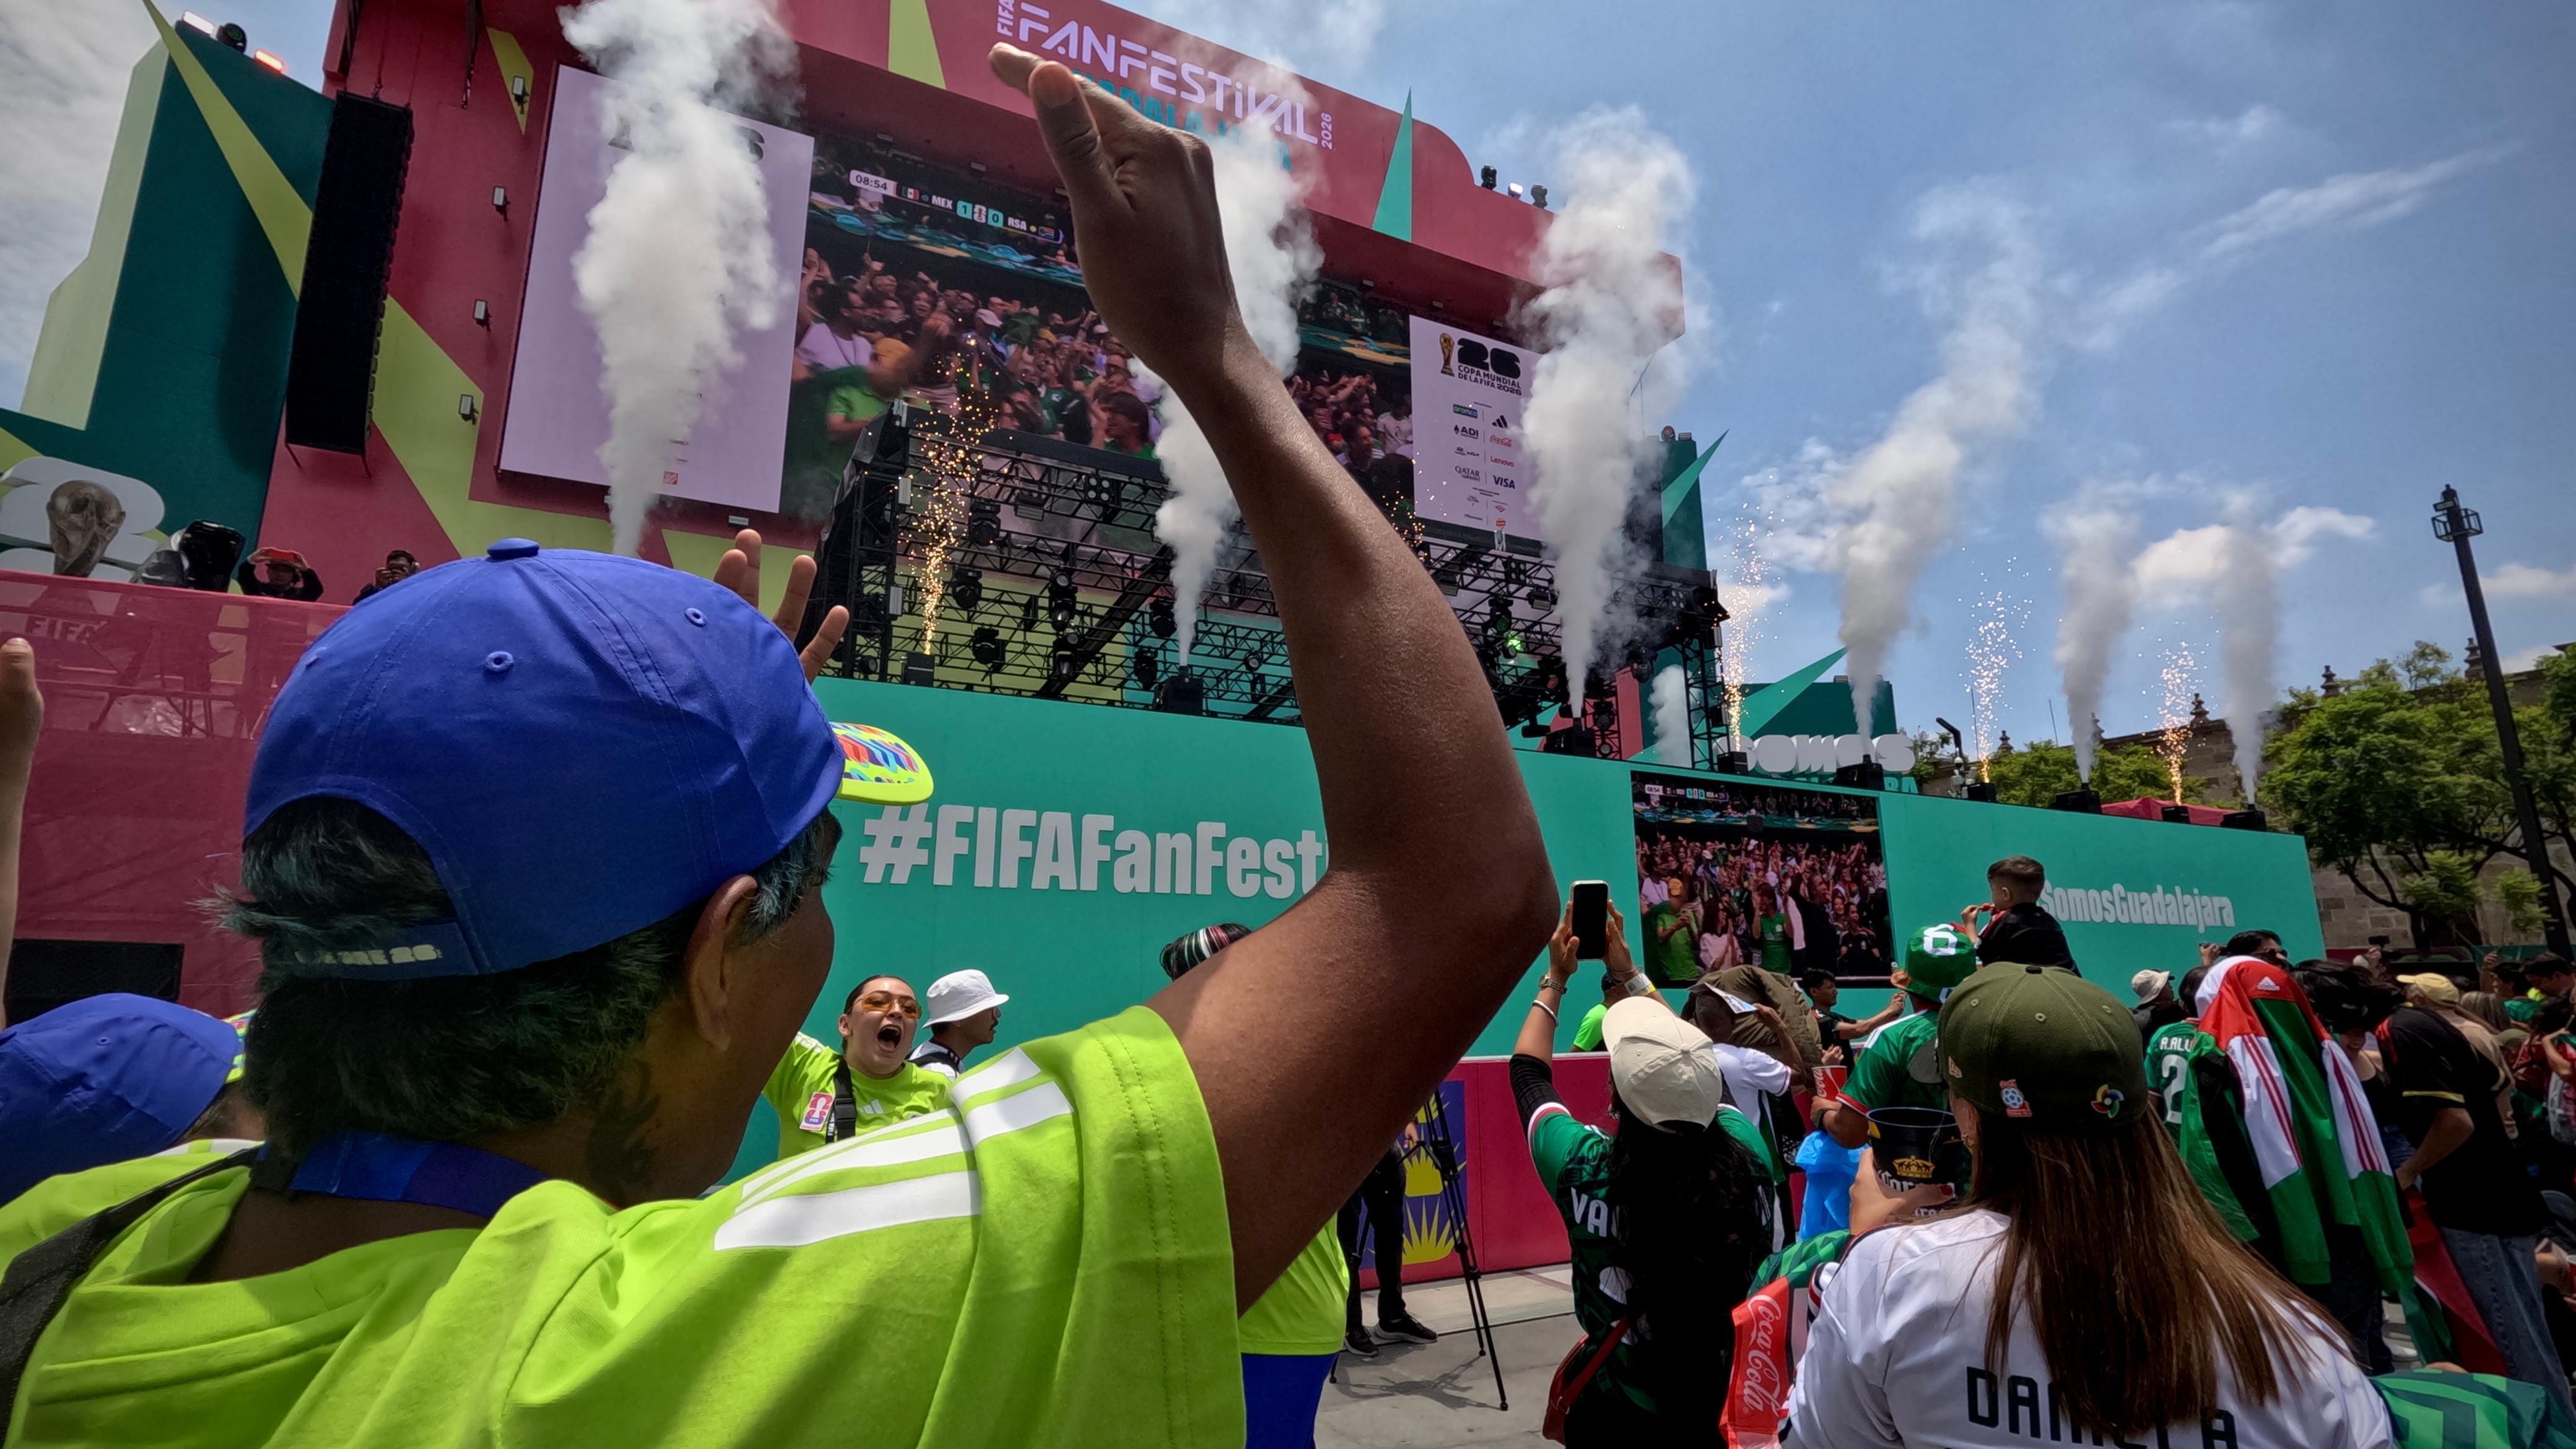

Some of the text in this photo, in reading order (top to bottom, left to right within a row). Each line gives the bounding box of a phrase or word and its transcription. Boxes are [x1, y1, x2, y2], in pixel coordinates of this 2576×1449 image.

[997, 0, 1014, 37] FIFA
[1321, 112, 1333, 150] 2026
[855, 174, 1027, 231] 08:54 MEX 1 0 RSA
[1457, 337, 1521, 380] 26
[1458, 365, 1521, 389] COPA MUNDIAL
[1458, 373, 1522, 396] DE LA FIFA 2026
[1453, 406, 1477, 417] aramco
[1461, 426, 1479, 437] ADI
[1455, 466, 1480, 477] QATAR
[1490, 456, 1515, 467] Lenovo
[1492, 474, 1516, 490] VISA
[1714, 734, 1916, 773] SOMOS
[860, 803, 1329, 899] #FIFAFanFest
[2036, 880, 2235, 933] SomosGuadalajara
